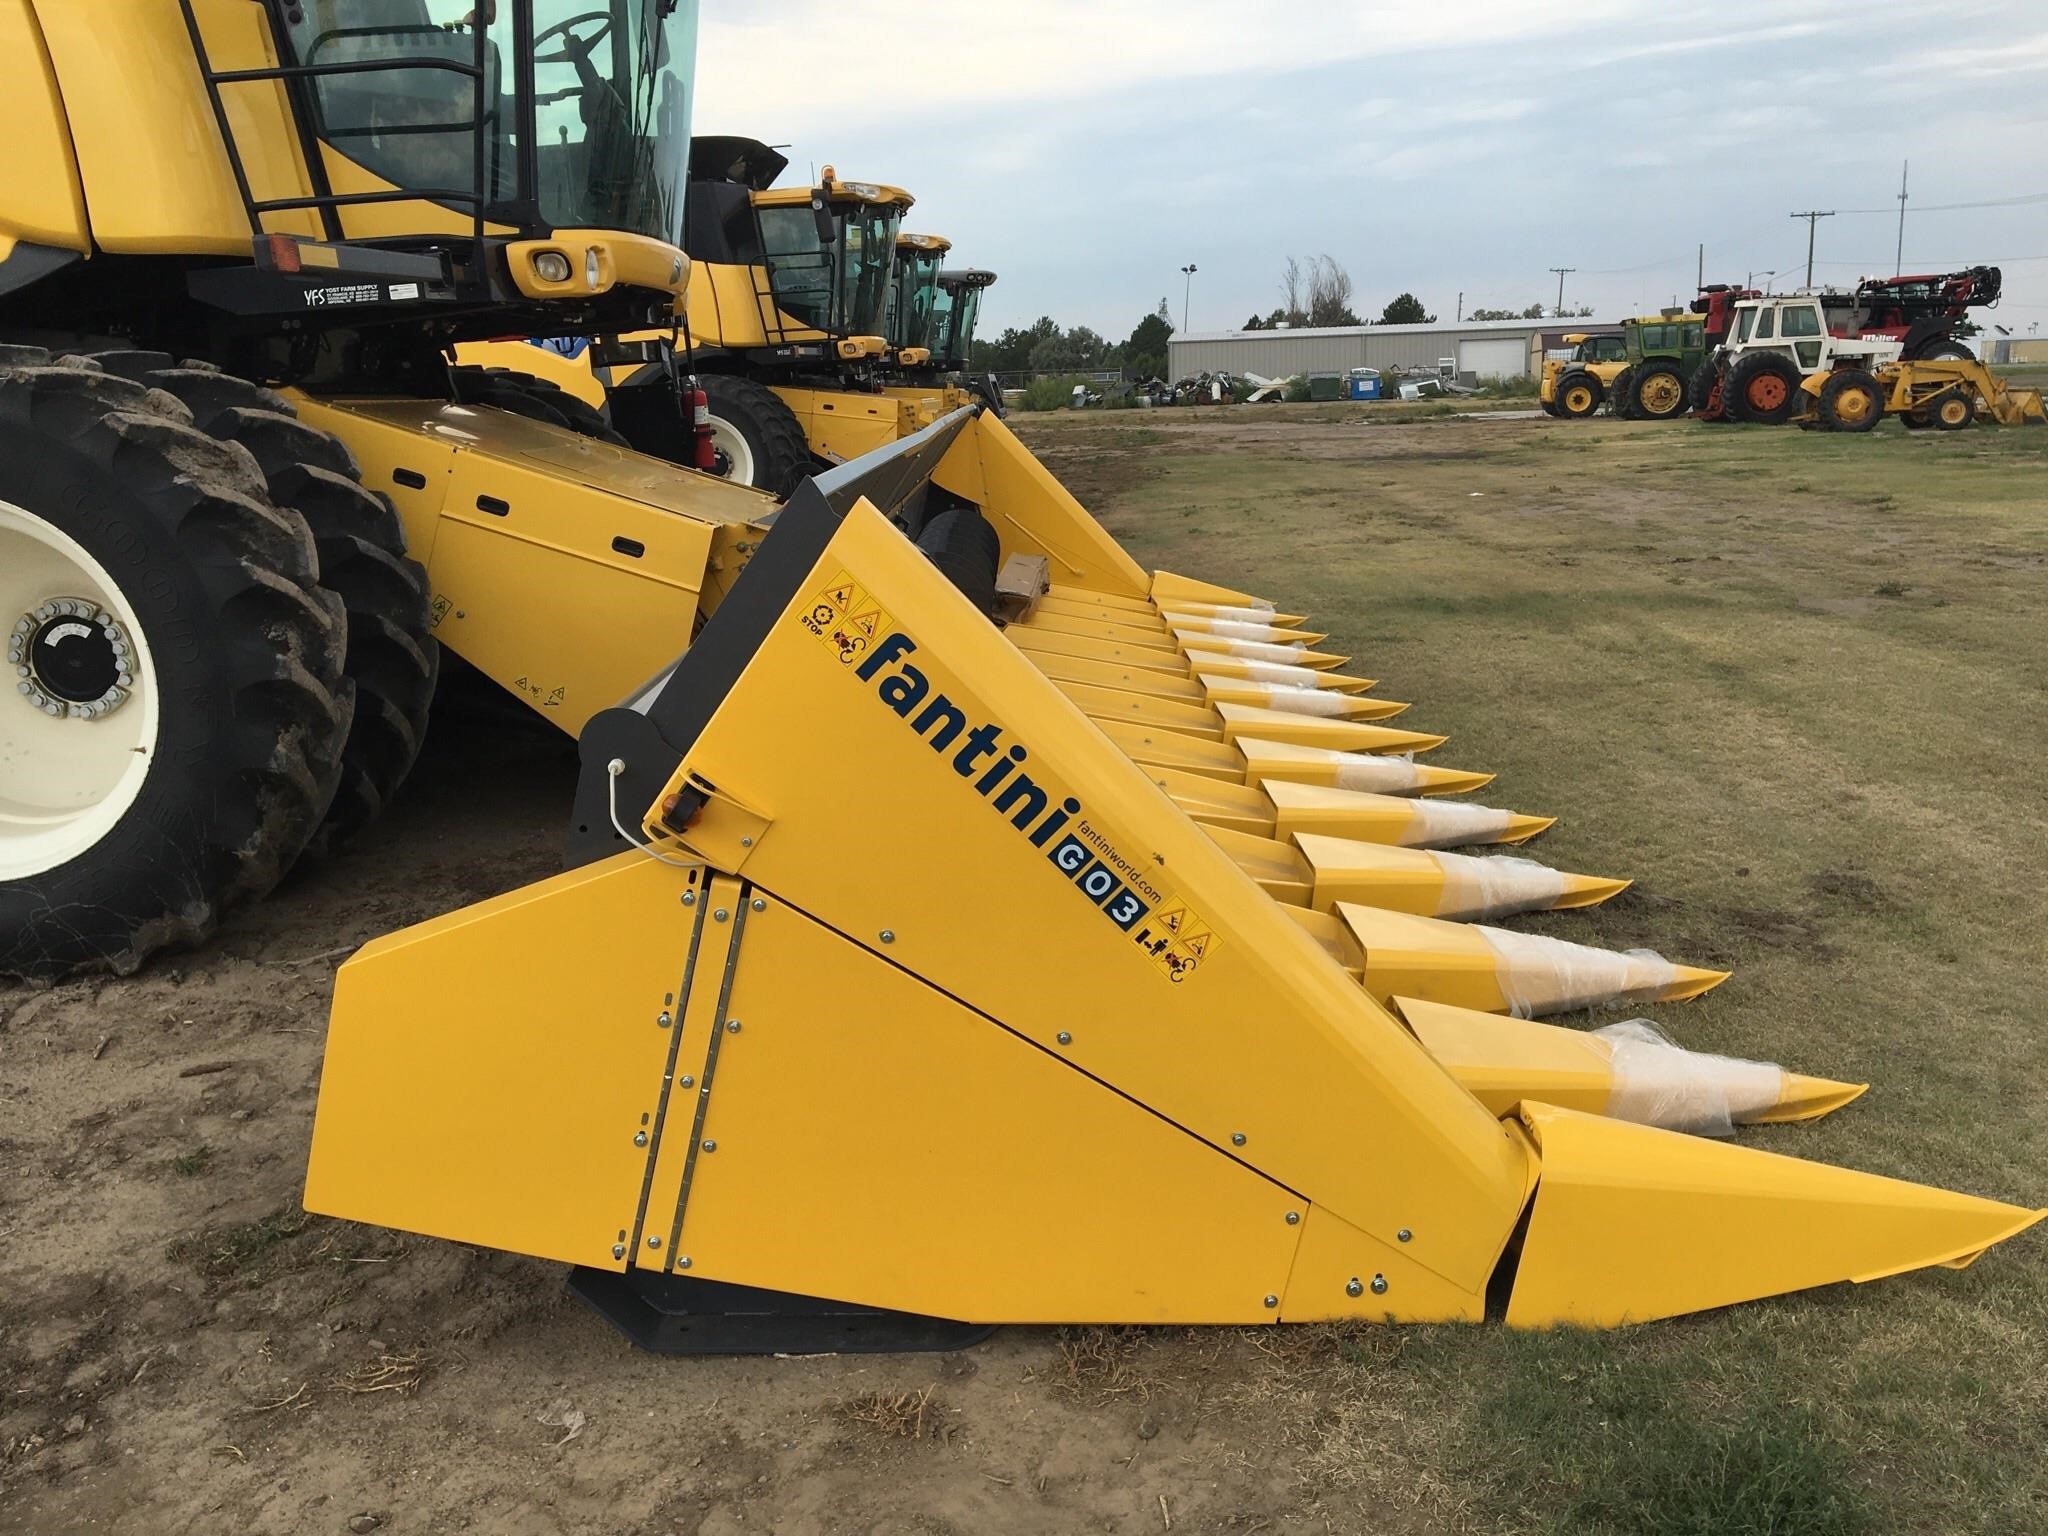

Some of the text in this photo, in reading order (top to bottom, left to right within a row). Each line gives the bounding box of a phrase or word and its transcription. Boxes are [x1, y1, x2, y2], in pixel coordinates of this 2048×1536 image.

[304, 288, 325, 306] YFS
[801, 615, 823, 636] STOP
[854, 632, 1081, 849] fantini
[1077, 820, 1162, 904] fantiniworld.com
